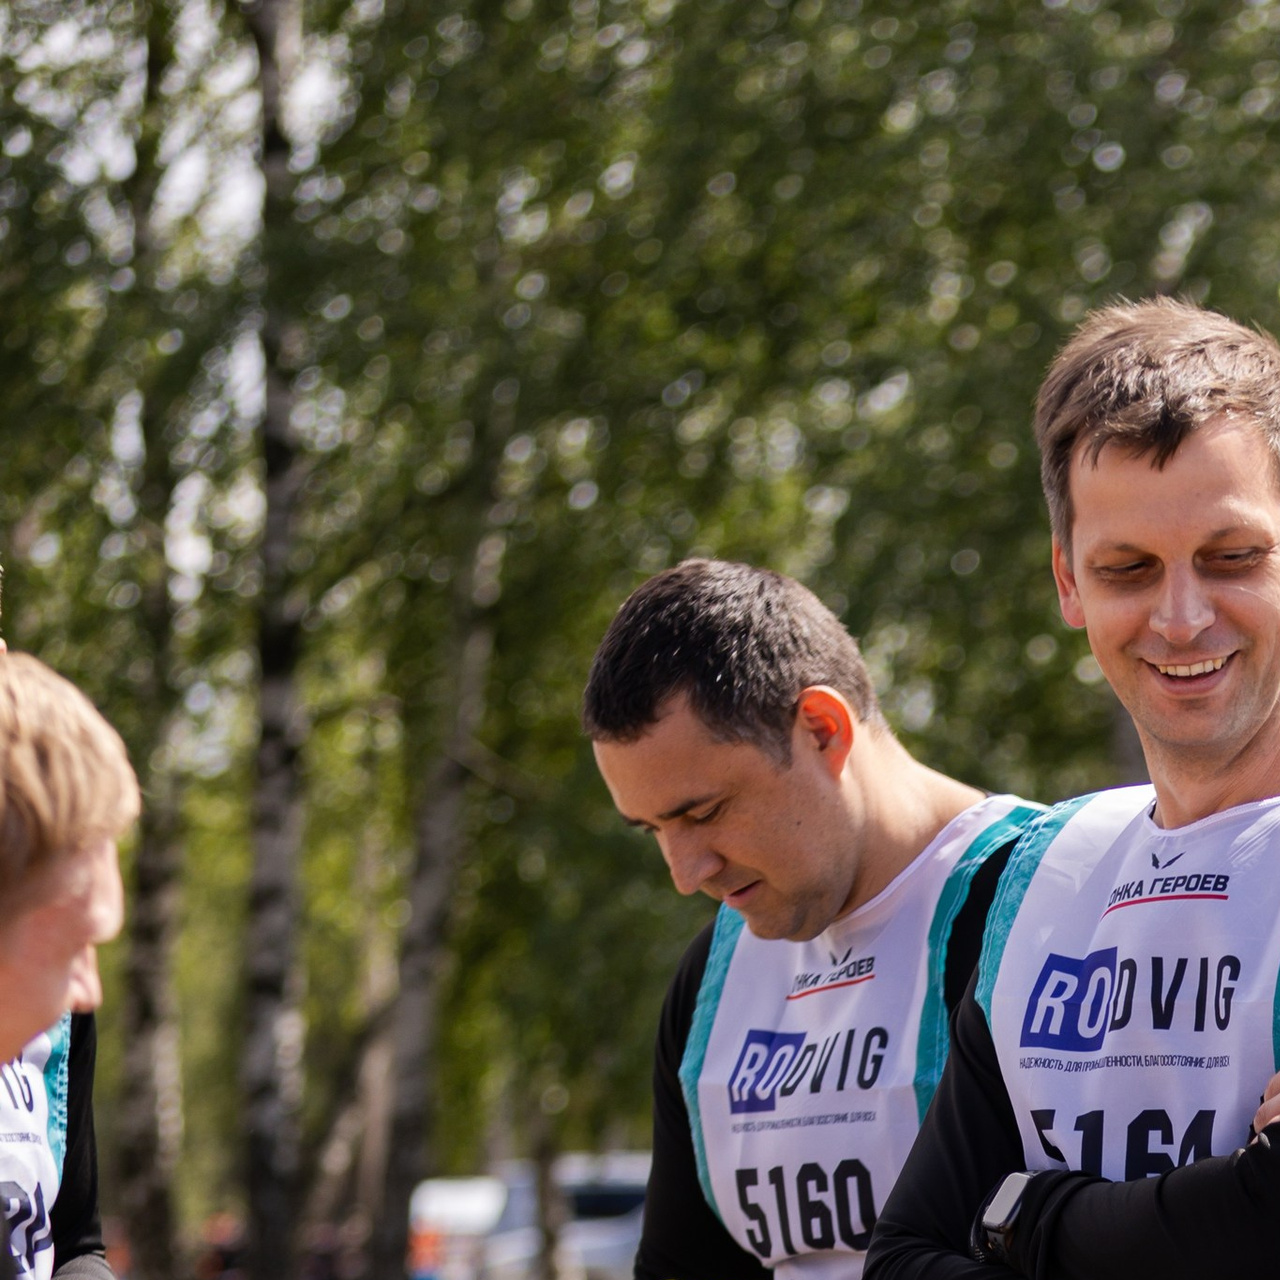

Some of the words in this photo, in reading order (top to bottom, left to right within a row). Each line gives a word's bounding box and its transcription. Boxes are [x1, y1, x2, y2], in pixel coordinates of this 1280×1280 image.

[1107, 879, 1145, 907] ОНКА
[1148, 873, 1230, 895] ГЕРОЕВ
[1027, 953, 1241, 1039] RODVIG
[731, 1026, 889, 1102] RODVIG
[735, 1158, 879, 1259] 5160
